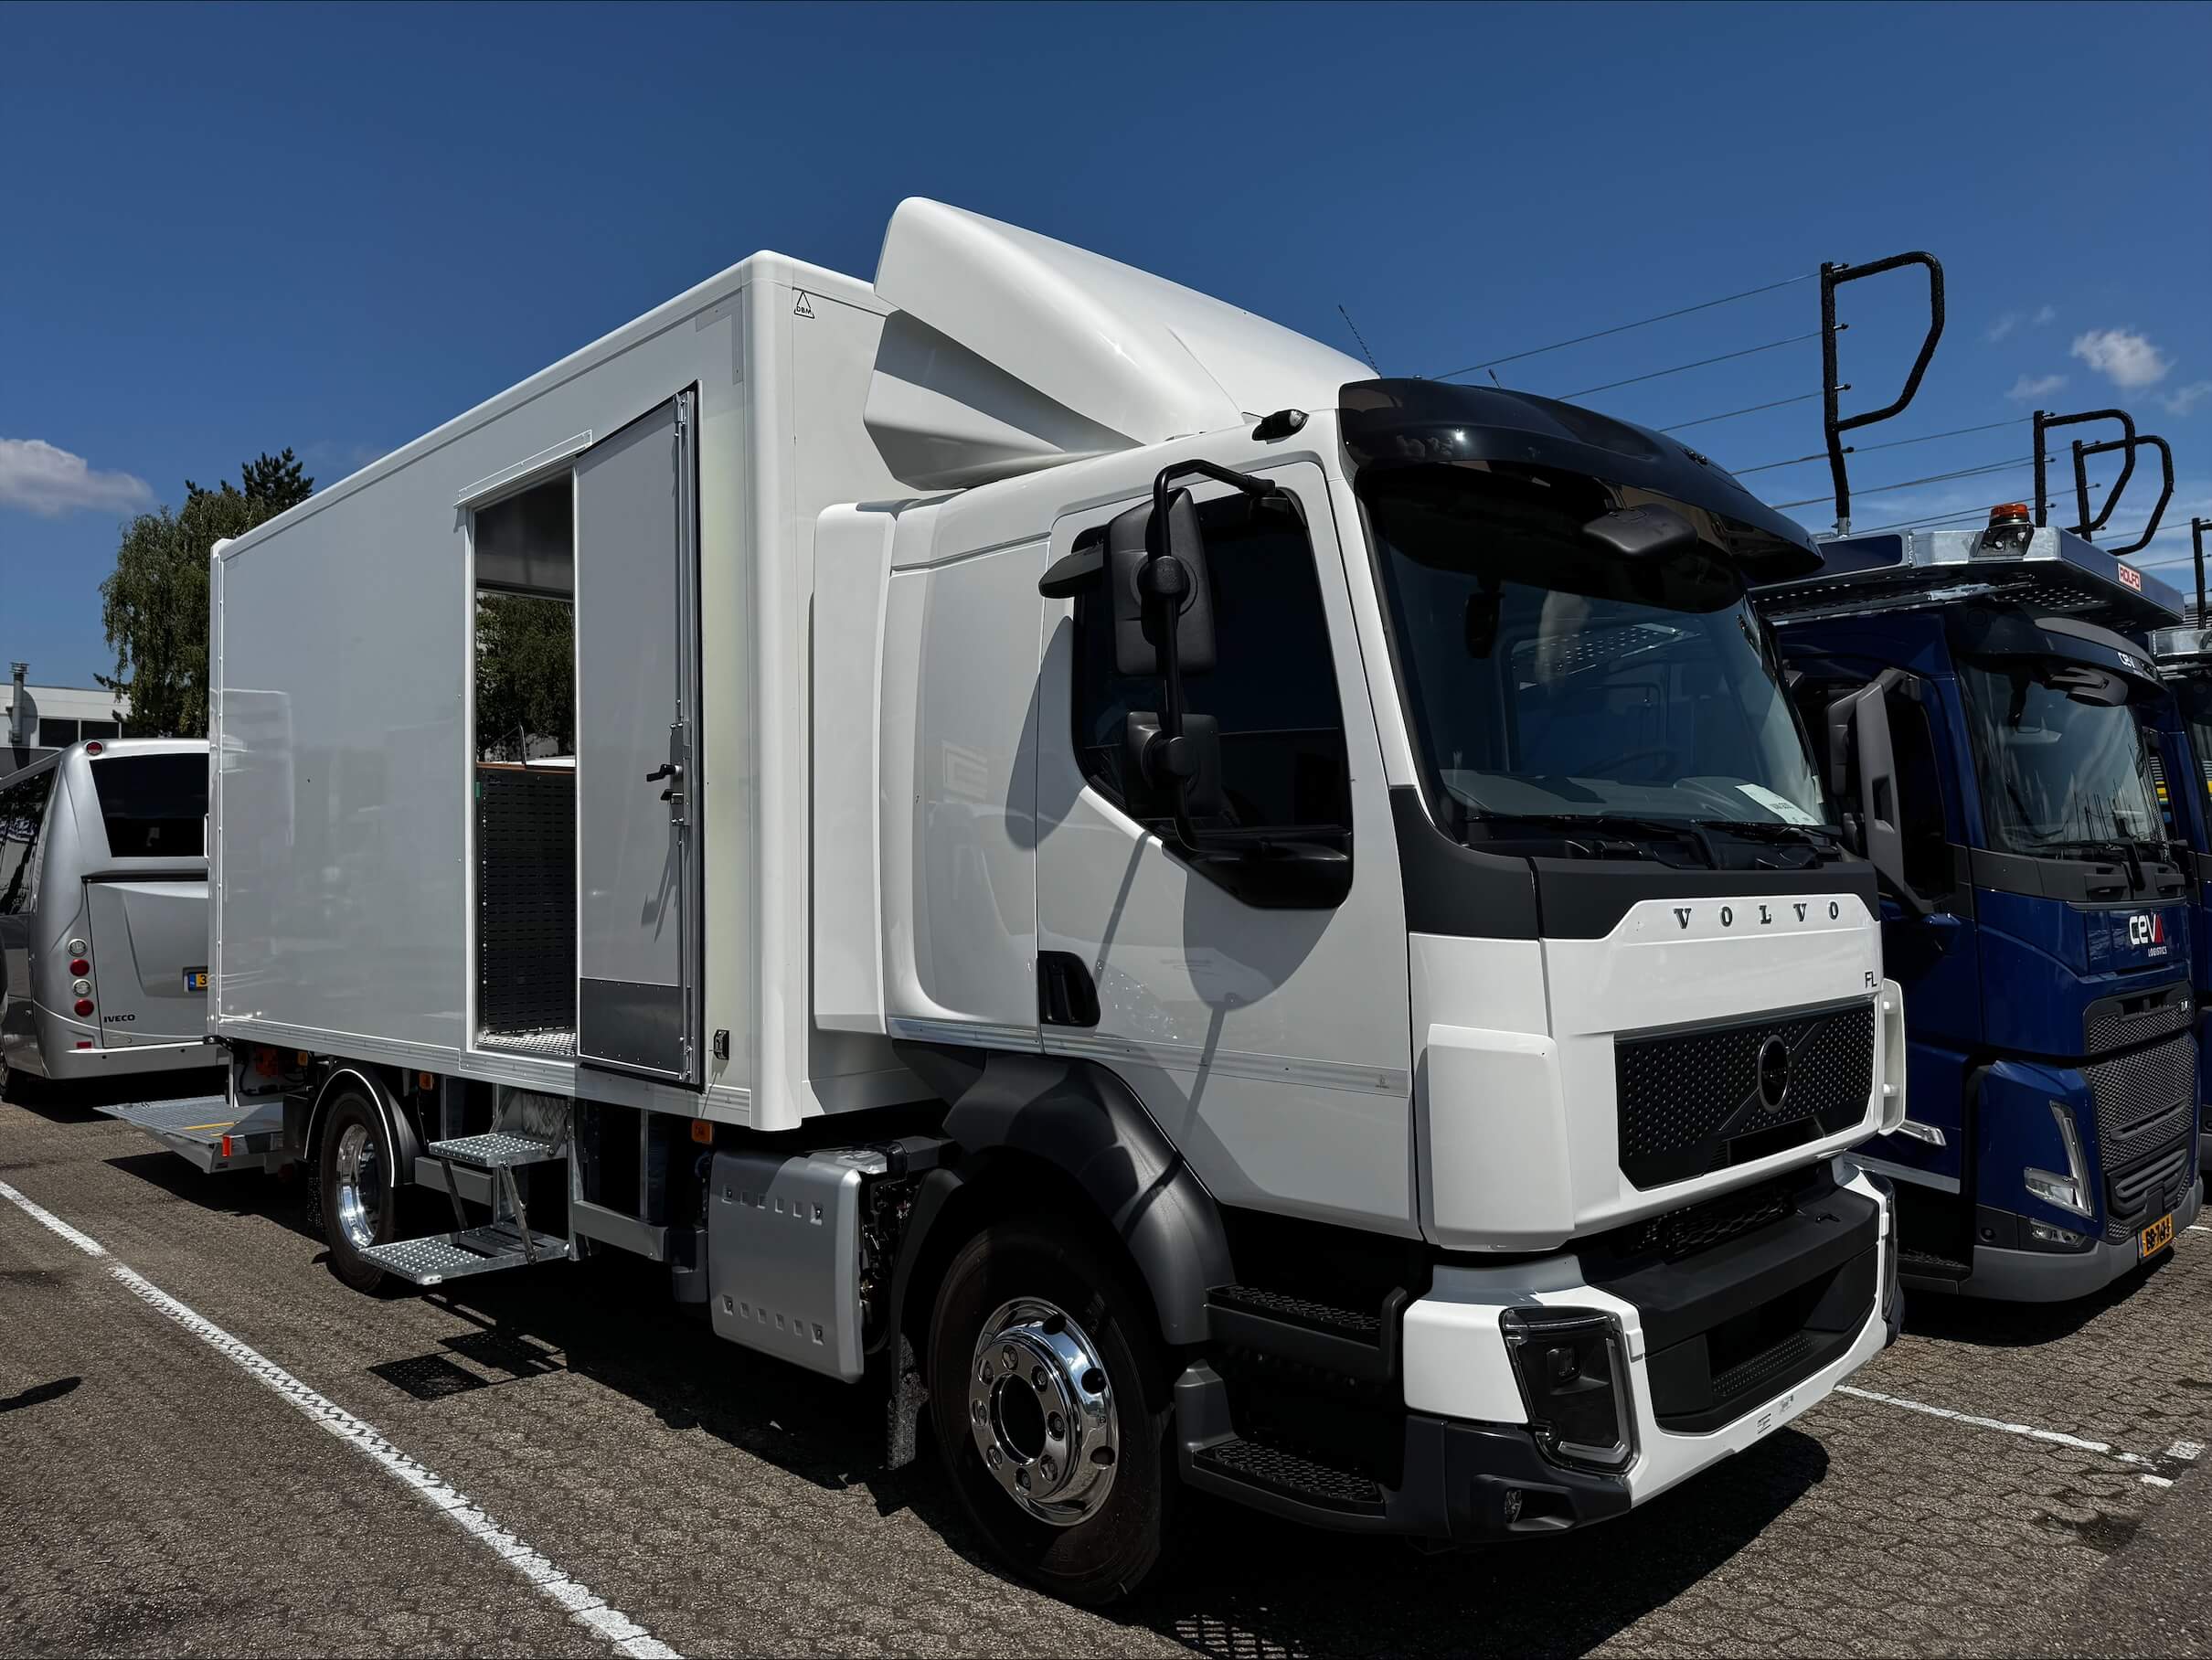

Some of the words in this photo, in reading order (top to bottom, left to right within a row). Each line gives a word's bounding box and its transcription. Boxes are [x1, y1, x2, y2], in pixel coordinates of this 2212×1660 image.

[2120, 566, 2141, 589] ROLFO
[1673, 901, 1839, 930] VOLVO
[2147, 945, 2168, 958] LOGISTICS
[1865, 971, 1878, 988] FL
[103, 1014, 136, 1023] IVECO
